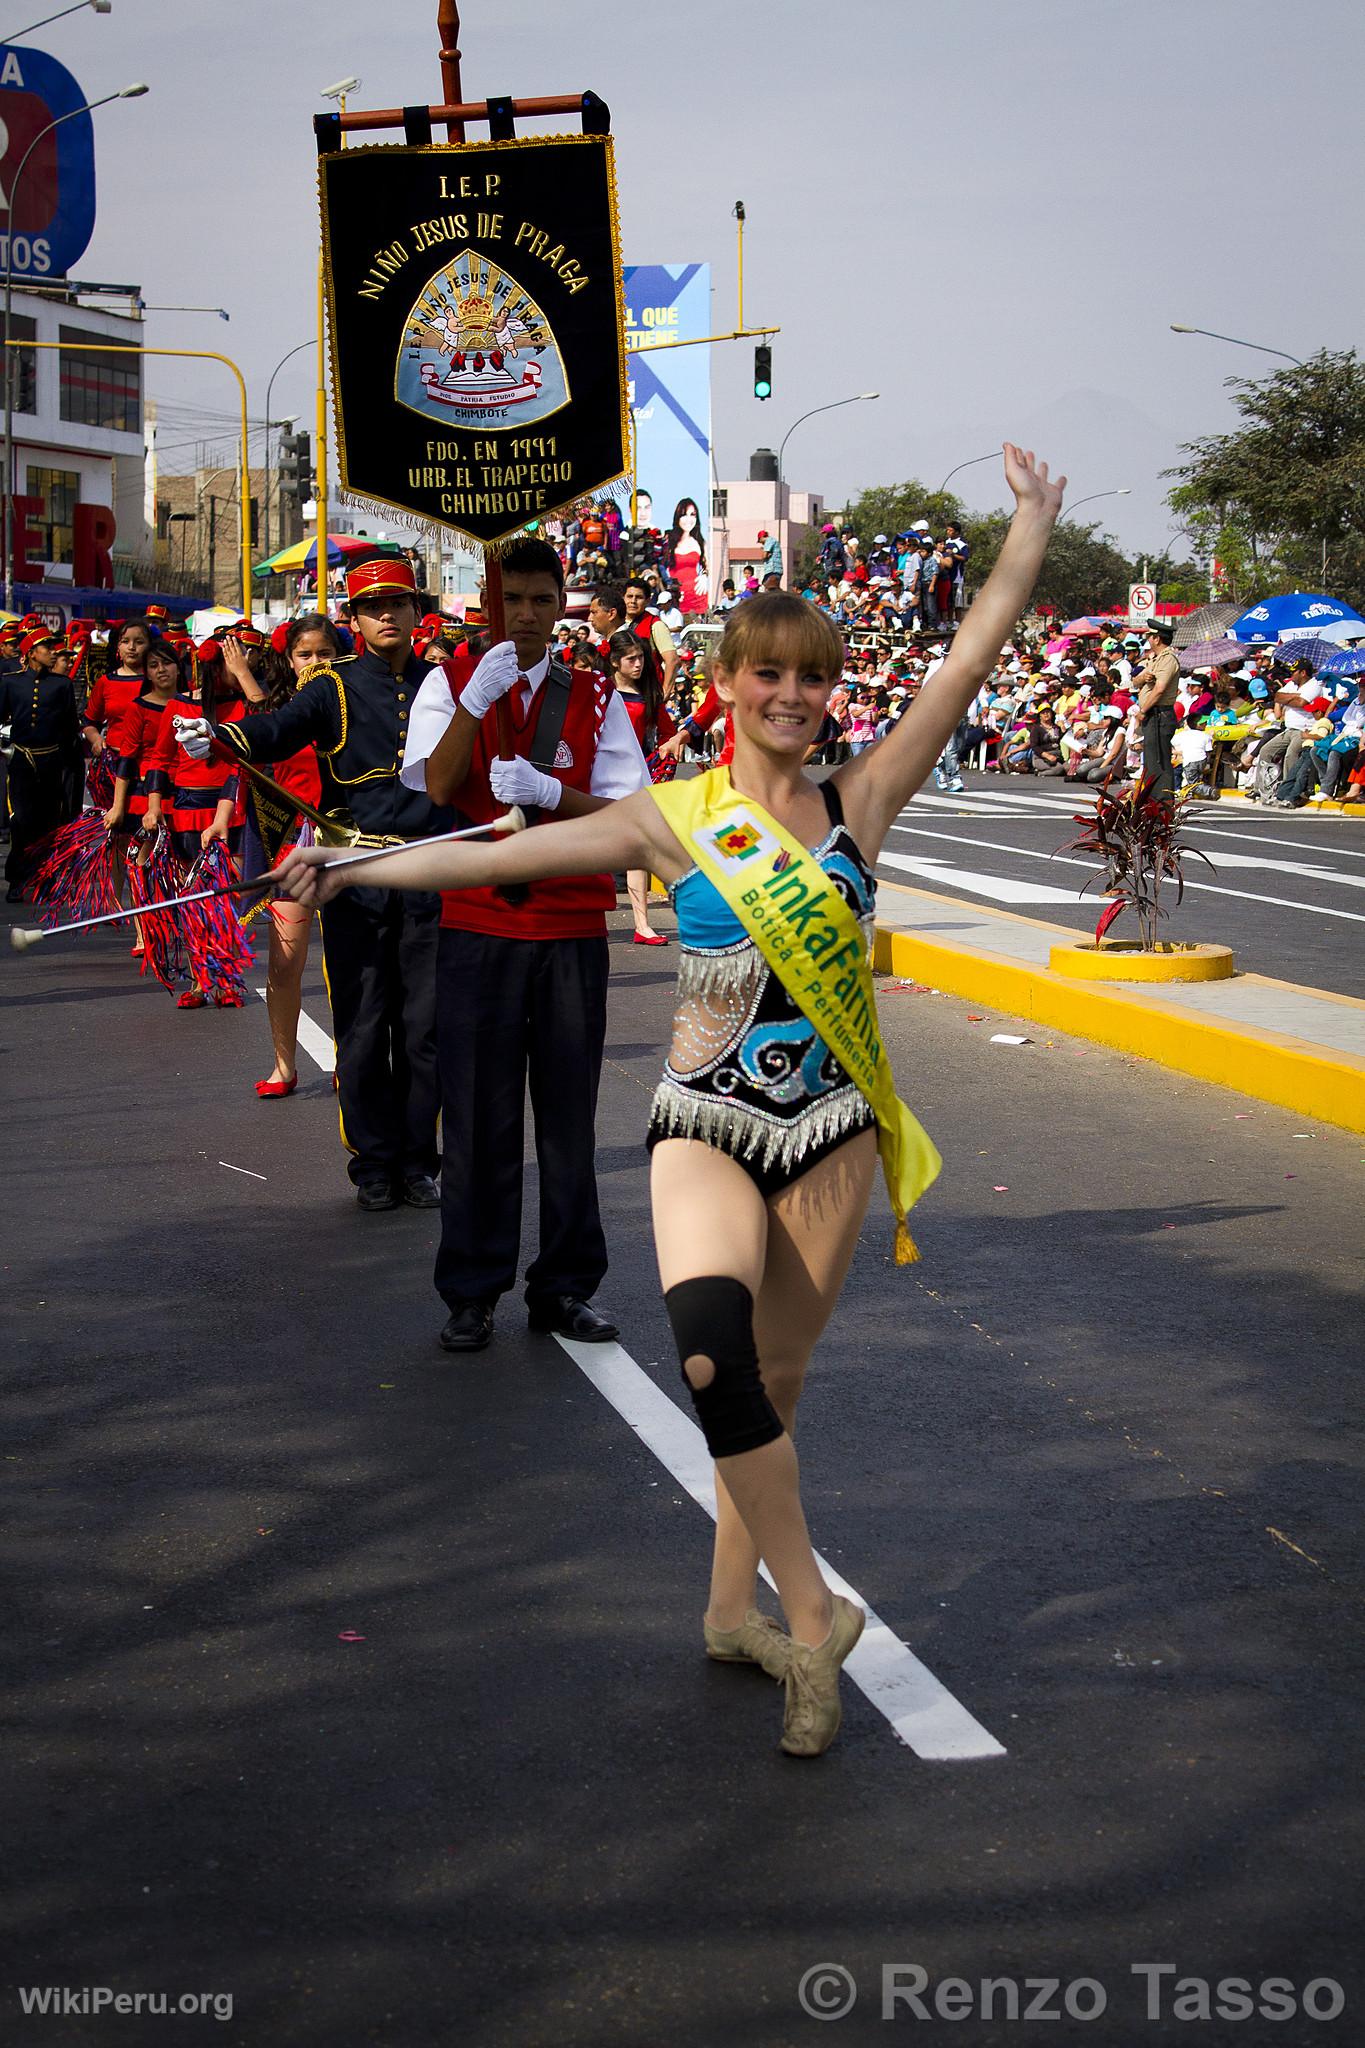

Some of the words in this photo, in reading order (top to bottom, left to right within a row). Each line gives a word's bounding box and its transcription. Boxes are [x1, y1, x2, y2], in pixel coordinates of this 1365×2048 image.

[358, 240, 409, 300] NIÑO
[410, 213, 469, 252] JESUS
[477, 212, 504, 239] DE
[514, 222, 590, 295] PRAGA
[446, 272, 489, 295] JESUS
[493, 281, 512, 300] DE
[512, 302, 547, 356] PRAGA
[642, 306, 680, 329] QUE
[454, 408, 509, 419] CHIMBOTE
[408, 467, 452, 488] URB.
[456, 467, 474, 488] EL
[480, 460, 572, 488] TRAPECIO
[474, 440, 498, 461] EN
[510, 436, 556, 459] 1991
[440, 489, 547, 515] CHIMBOTE
[0, 495, 117, 591] ER
[740, 888, 794, 964] Botica
[762, 859, 881, 1069] InkaFarma
